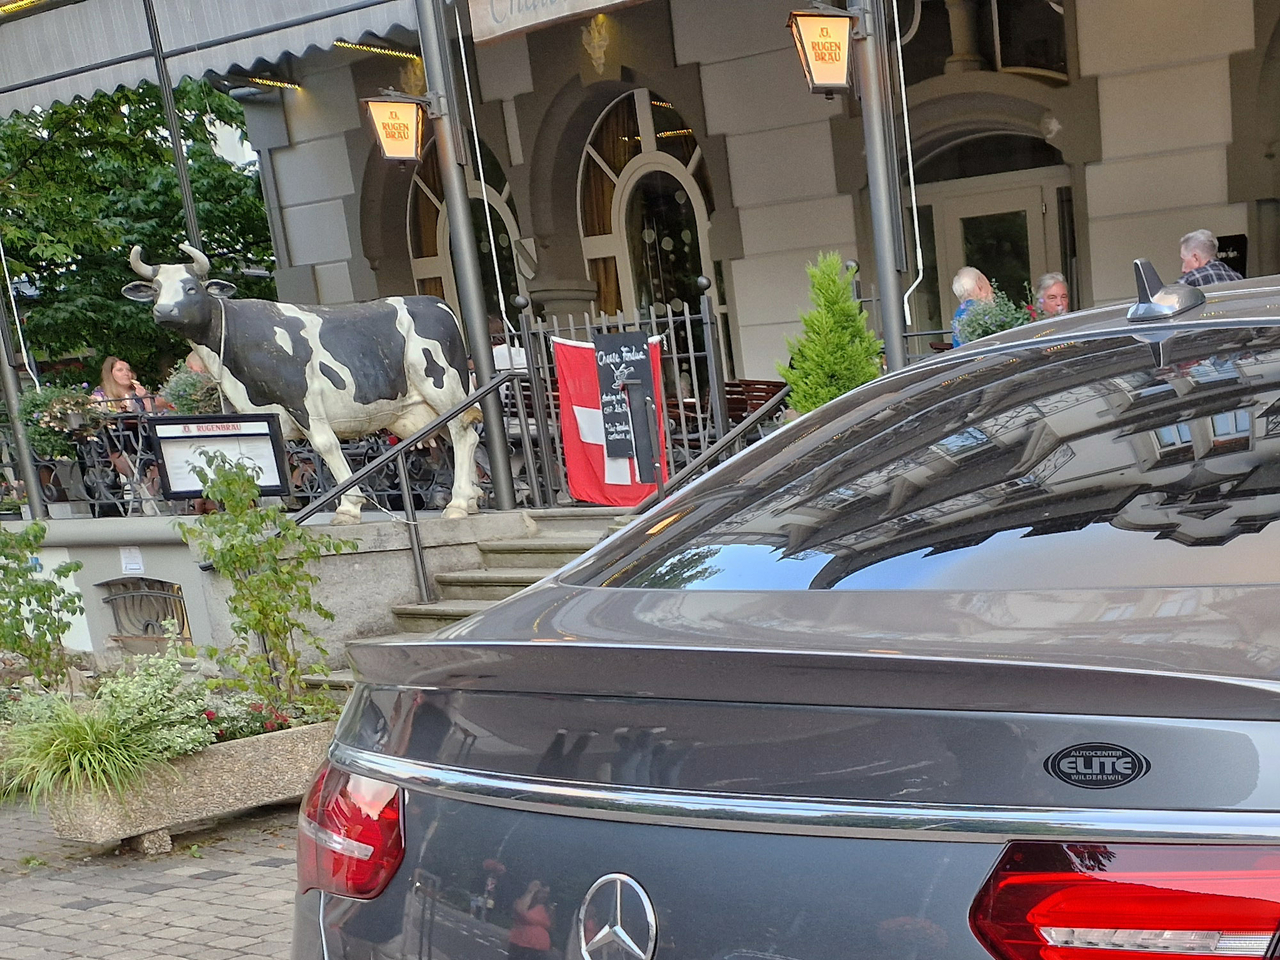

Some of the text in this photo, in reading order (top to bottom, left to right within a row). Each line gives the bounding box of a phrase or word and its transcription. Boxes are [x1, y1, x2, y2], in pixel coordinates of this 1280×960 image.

[811, 41, 841, 52] RUGEN
[382, 122, 409, 131] RUGEN
[1059, 757, 1132, 774] ELITE
